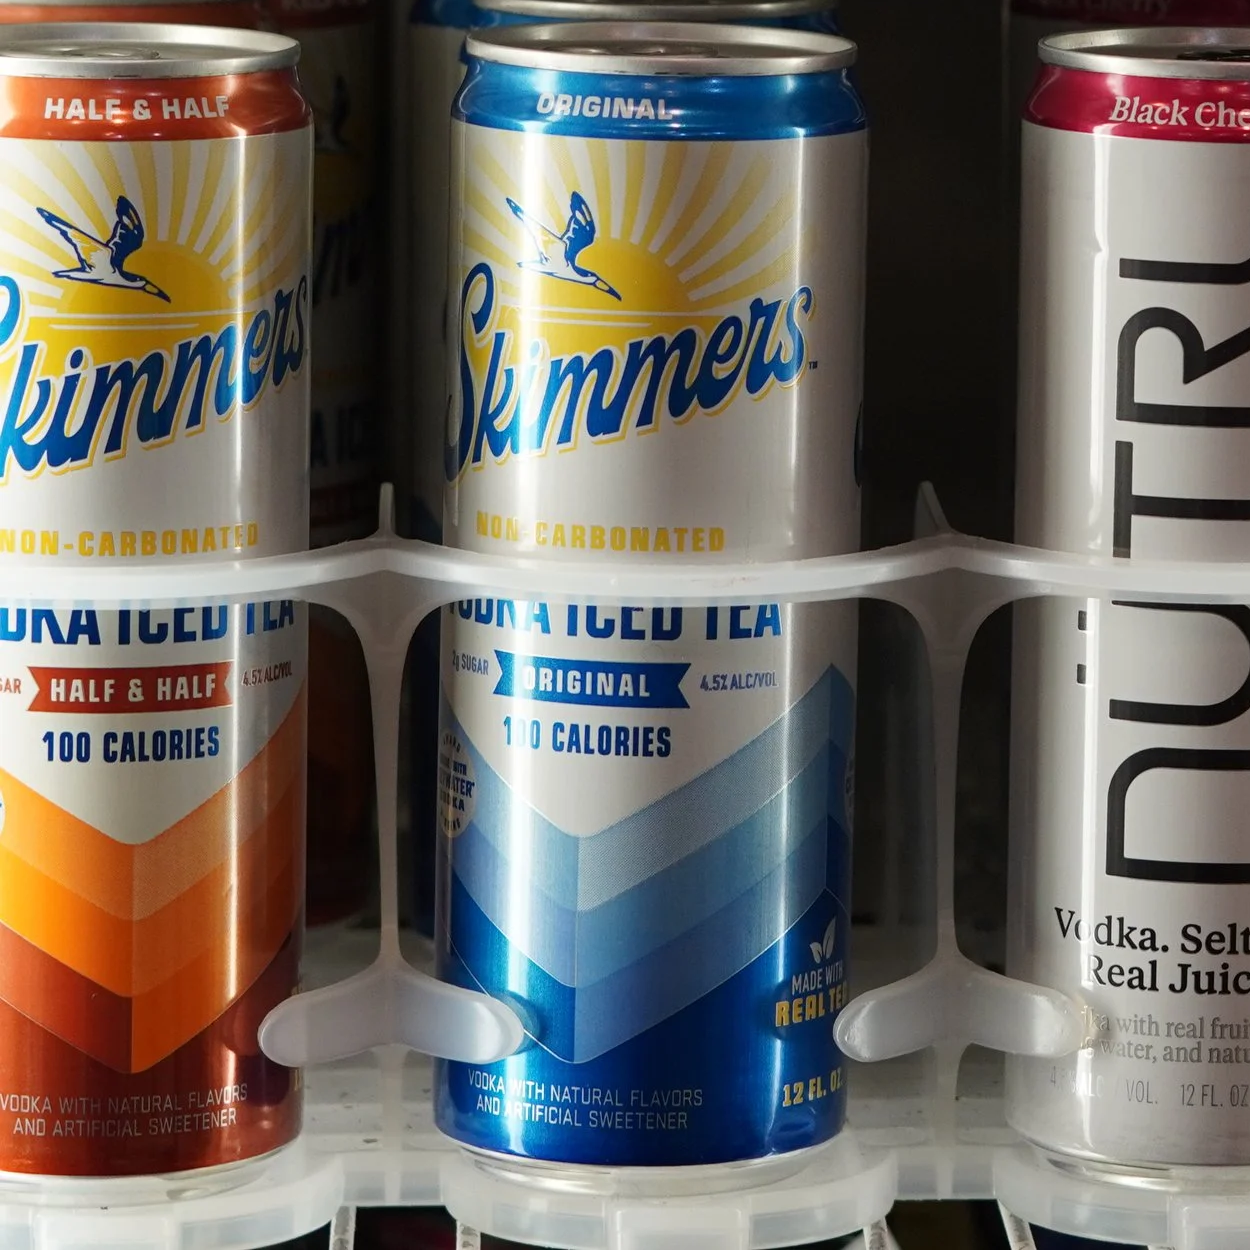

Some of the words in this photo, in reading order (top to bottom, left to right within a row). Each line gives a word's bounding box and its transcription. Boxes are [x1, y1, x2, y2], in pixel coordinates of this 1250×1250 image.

[44, 97, 121, 121] HALF
[133, 98, 152, 120] &
[162, 96, 230, 119] HALF
[536, 93, 676, 121] ORIGINAL
[1109, 96, 1189, 128] Black
[0, 522, 260, 557] NON-CARBONATED
[461, 653, 489, 676] SUGAR
[522, 662, 651, 698] ORIGINAL
[700, 672, 729, 691] 4.5%
[730, 671, 781, 690] ALC/VOL
[50, 678, 115, 702] HALF
[128, 677, 145, 701] &
[157, 673, 217, 700] HALF
[43, 730, 91, 762] 100
[103, 725, 220, 764] CALORIES
[552, 720, 672, 759] CALORIES
[1054, 907, 1169, 953] Vodka.
[1085, 953, 1159, 992] Real
[0, 1094, 53, 1114] VODKA
[59, 1096, 100, 1115] WITH
[108, 1093, 183, 1115] NATURAL
[188, 1082, 248, 1109] FLAVORS
[468, 1068, 505, 1093] VODKA
[510, 1079, 545, 1102] WITH
[550, 1085, 624, 1106] NATURAL
[630, 1089, 703, 1107] FLAVORS
[1125, 1078, 1159, 1105] VOL.
[1180, 1083, 1195, 1106] 12
[1200, 1084, 1224, 1108] FL.
[13, 1117, 46, 1136] AND
[52, 1116, 143, 1138] ARTIFICIAL
[149, 1107, 237, 1136] SWEETENER
[477, 1095, 500, 1117] AND
[504, 1100, 582, 1128] ARTIFICIAL
[588, 1110, 688, 1130] SWEETENER
